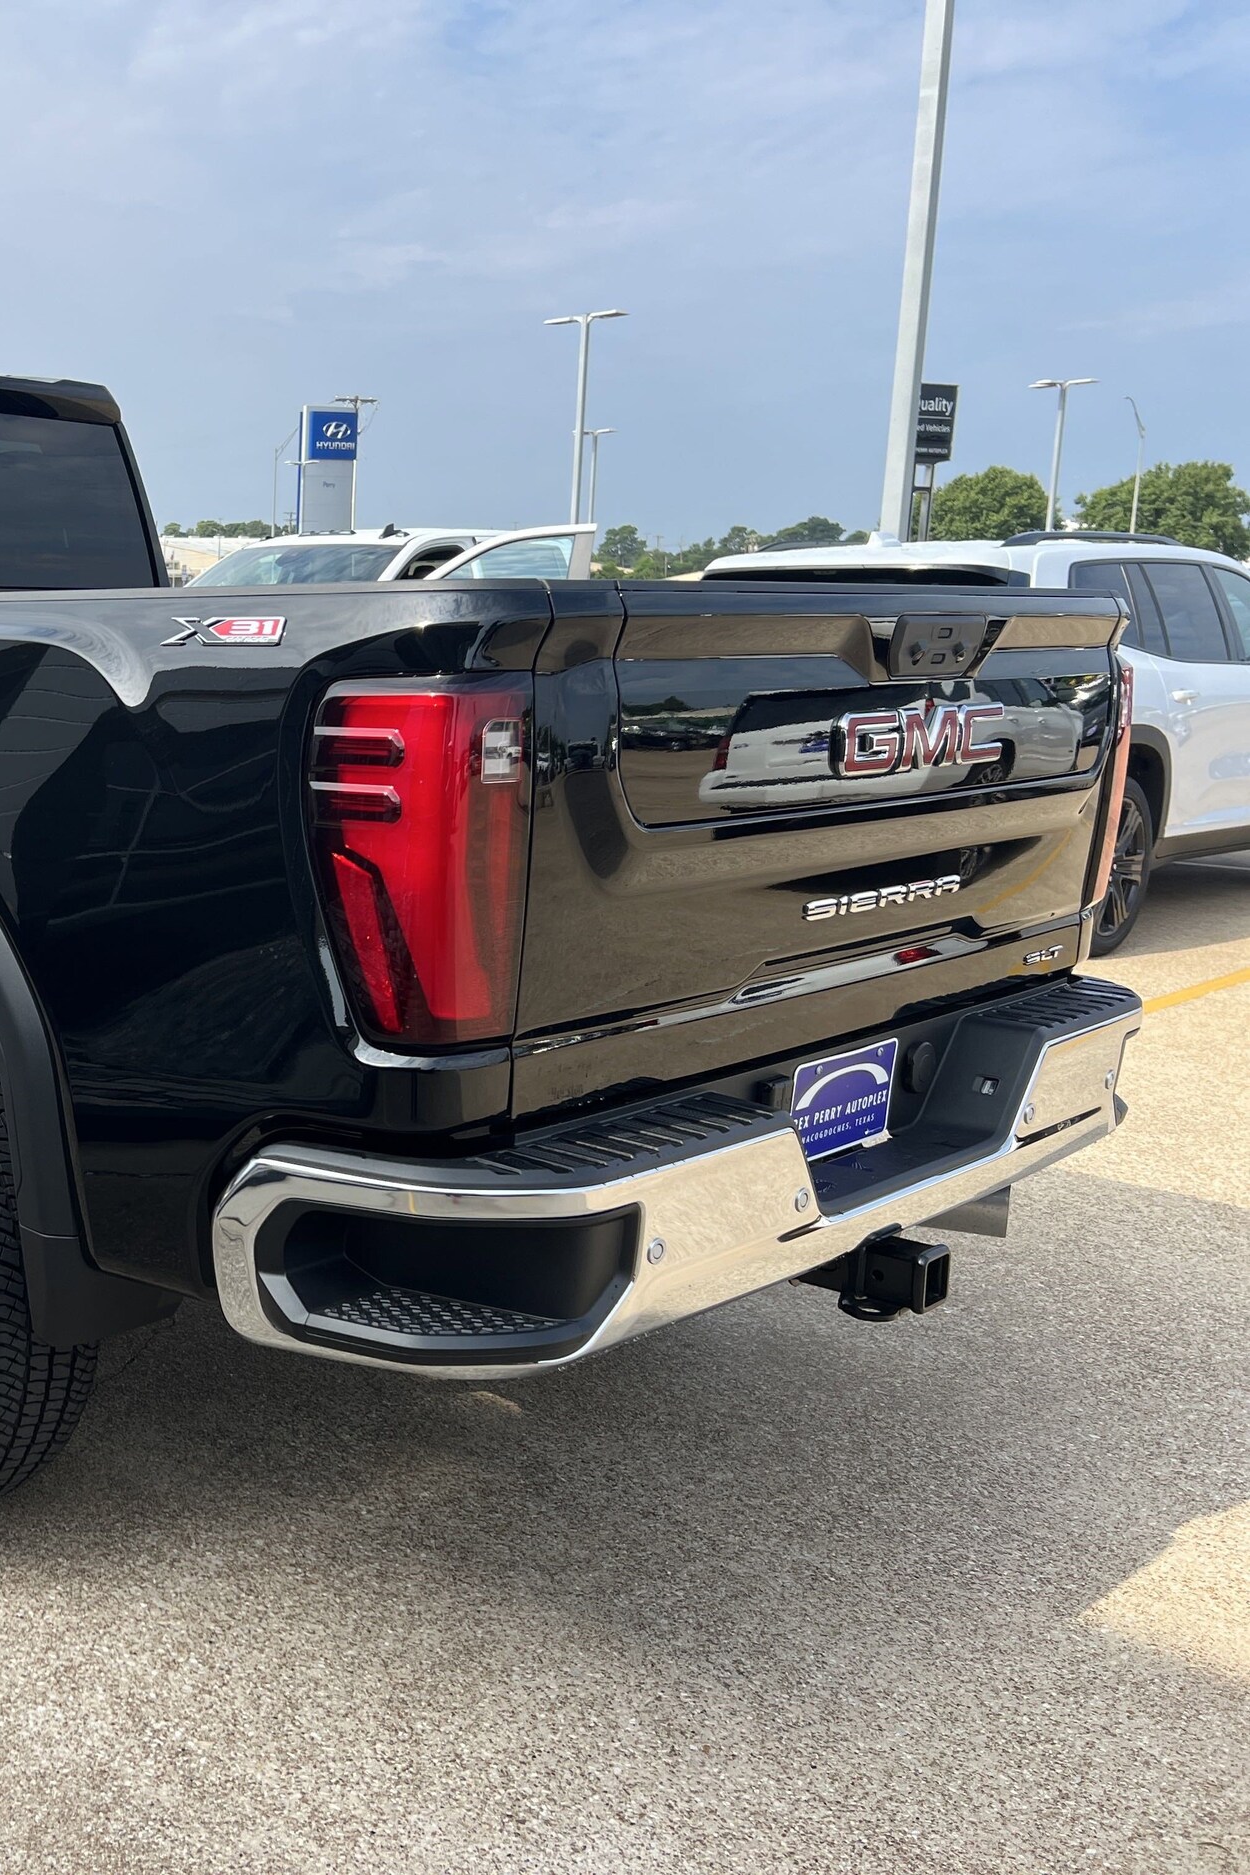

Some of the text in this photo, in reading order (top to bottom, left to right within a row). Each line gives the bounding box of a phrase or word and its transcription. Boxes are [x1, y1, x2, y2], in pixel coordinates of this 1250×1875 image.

[919, 397, 954, 416] uality
[316, 440, 355, 450] HYUNDAI
[160, 616, 287, 647] X31
[828, 702, 1005, 777] GMC
[802, 874, 962, 922] SIERRA
[1022, 944, 1064, 966] SLT
[813, 1104, 843, 1125] PERRY
[845, 1089, 888, 1115] AUTOPLEX
[855, 1113, 875, 1126] TEXAS
